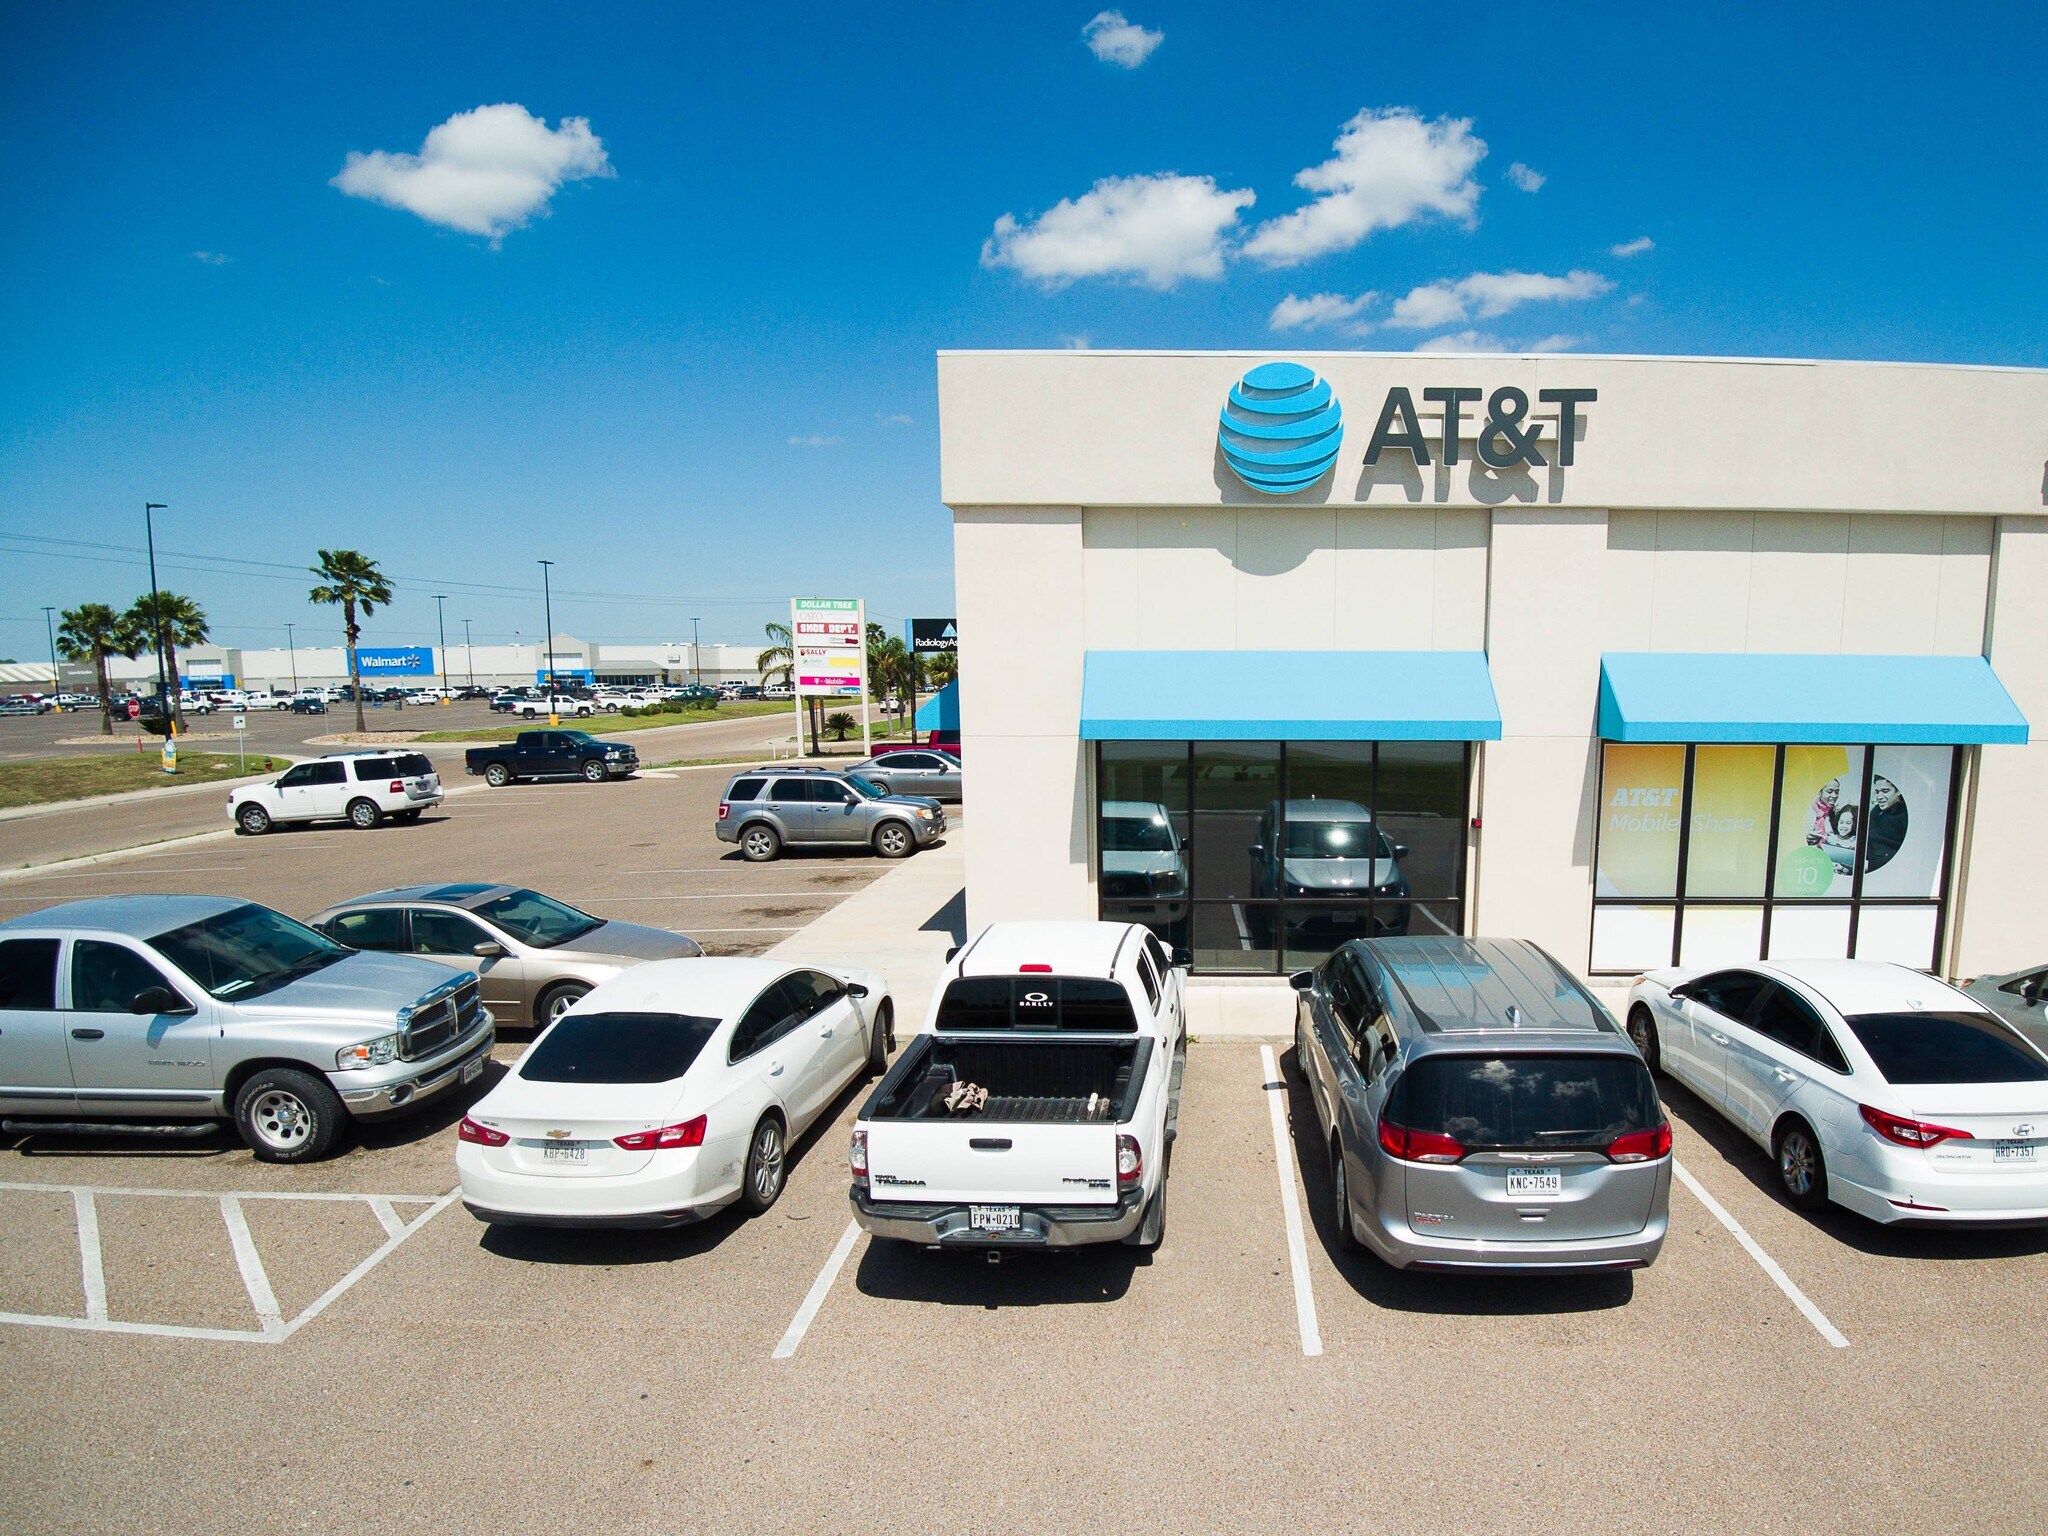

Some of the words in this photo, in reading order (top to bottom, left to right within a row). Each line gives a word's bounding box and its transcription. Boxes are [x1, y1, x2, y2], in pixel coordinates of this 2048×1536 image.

[1362, 386, 1597, 469] AT&T
[833, 601, 853, 609] TREE
[799, 611, 823, 621] CATO
[800, 623, 825, 633] SHOE
[828, 624, 856, 634] DEPT.
[915, 638, 949, 648] Radiology
[361, 656, 407, 667] Walmart
[1610, 788, 1679, 807] AT&T
[1609, 813, 1680, 833] Mobile
[1690, 812, 1755, 833] Share
[1796, 866, 1818, 885] 10
